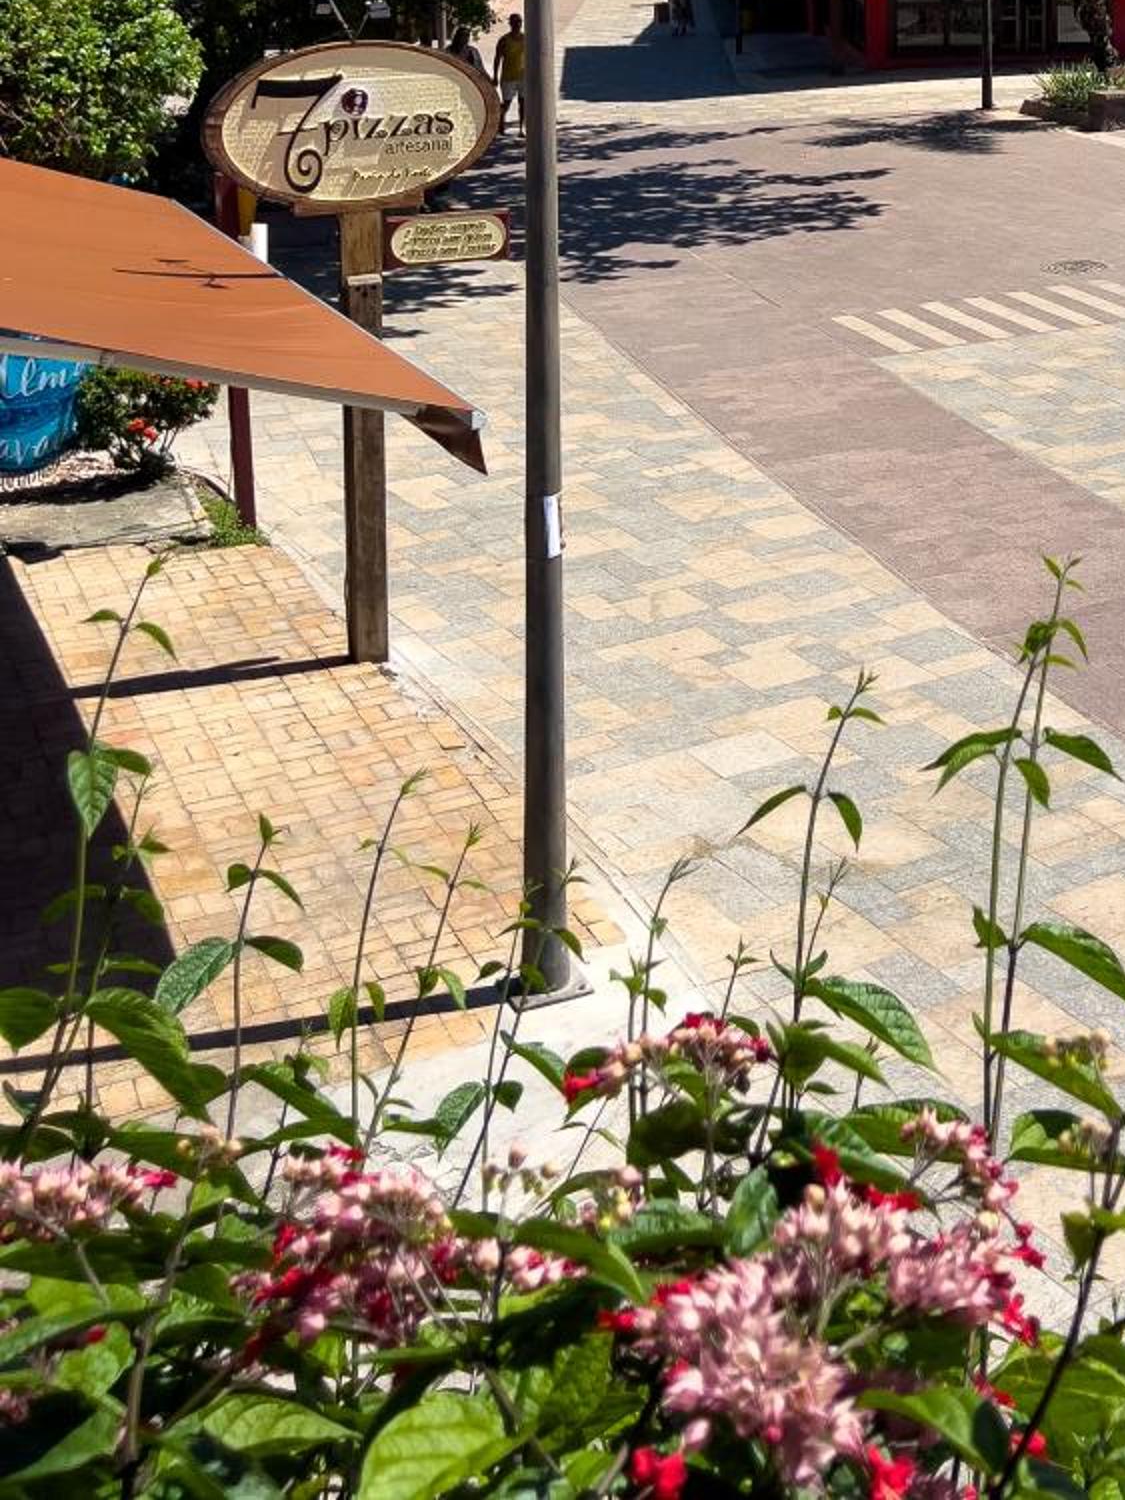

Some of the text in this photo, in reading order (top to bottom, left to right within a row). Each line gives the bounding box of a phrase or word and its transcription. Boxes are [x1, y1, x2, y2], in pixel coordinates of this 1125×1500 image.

[251, 74, 455, 194] 7 pizzas
[385, 135, 454, 155] artesanal
